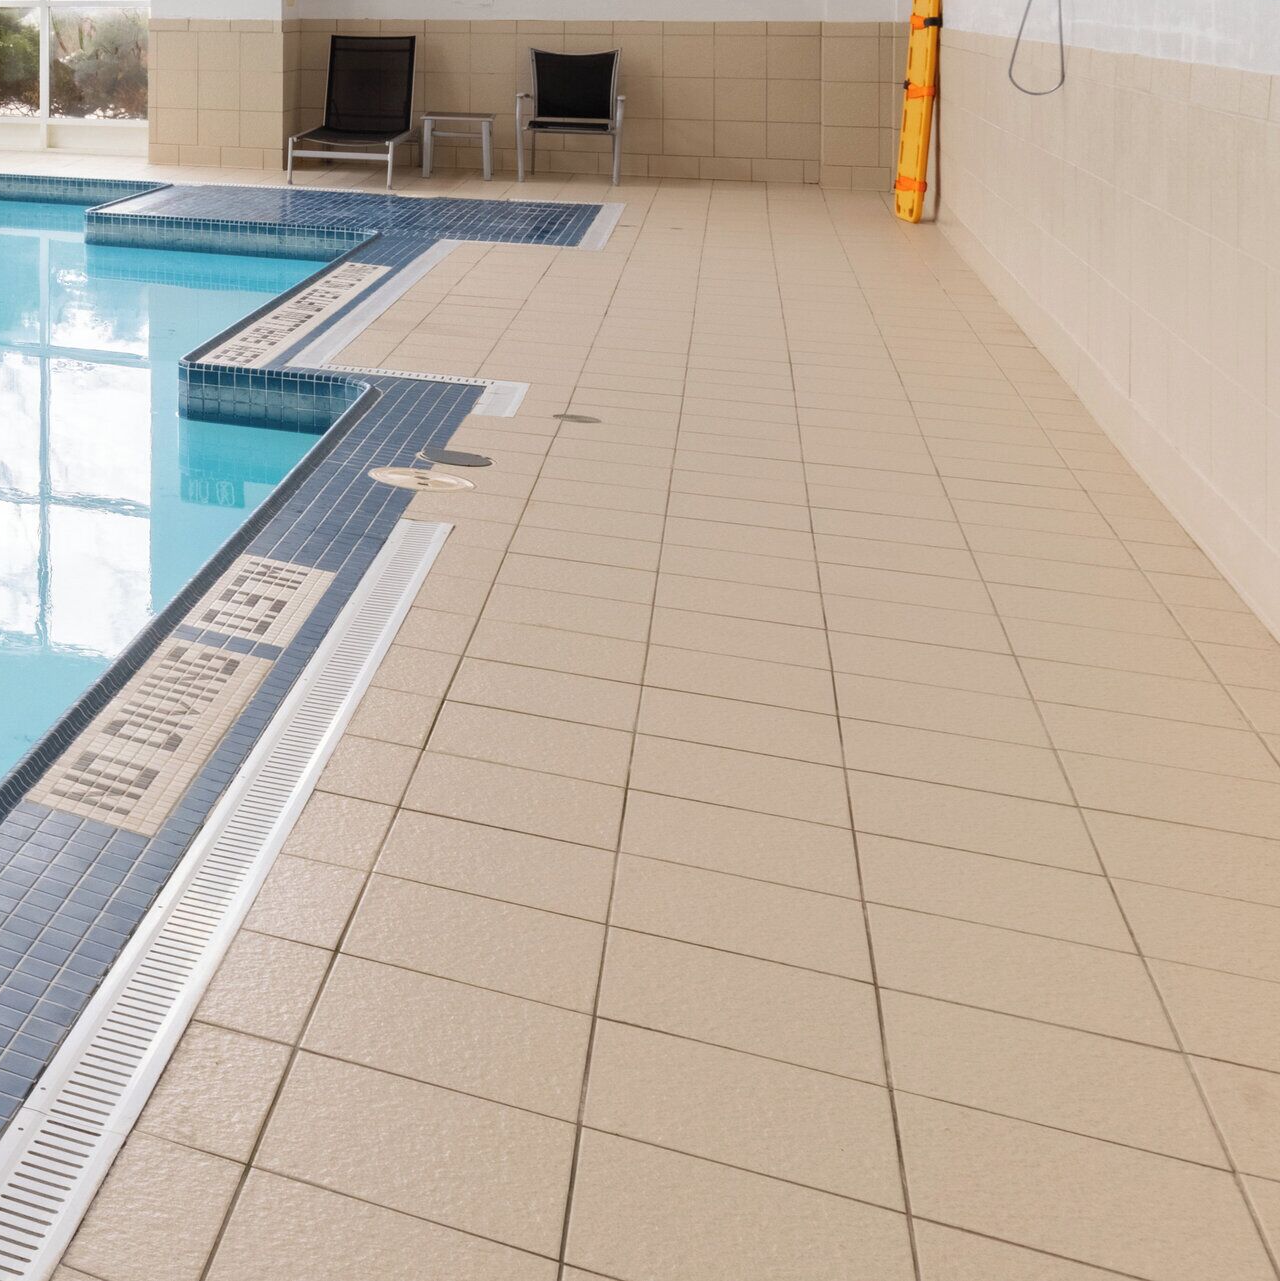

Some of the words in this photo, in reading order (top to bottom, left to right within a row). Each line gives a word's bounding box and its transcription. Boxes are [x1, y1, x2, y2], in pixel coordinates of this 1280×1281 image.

[241, 310, 314, 346] SHALLOW
[286, 288, 341, 312] WATER
[102, 646, 241, 752] DIVING
[50, 750, 160, 816] NO
